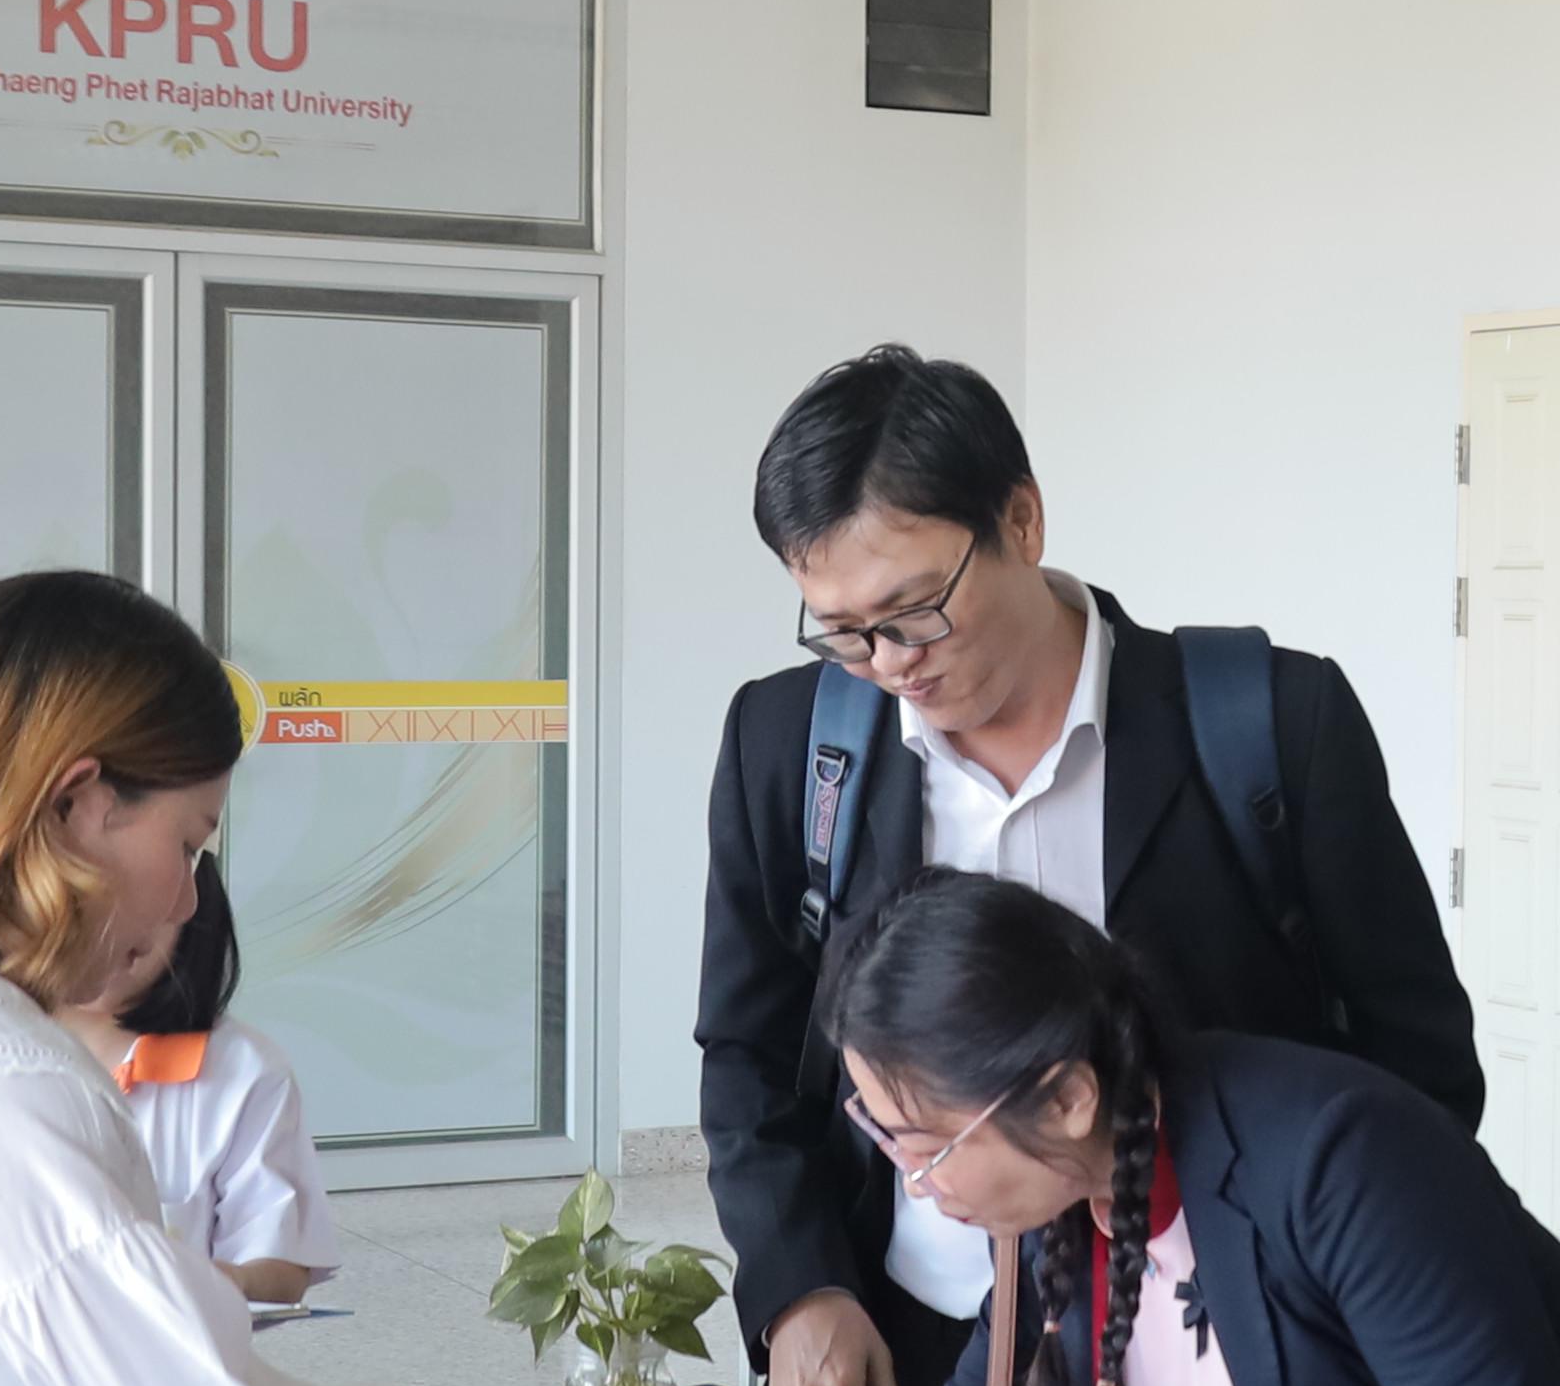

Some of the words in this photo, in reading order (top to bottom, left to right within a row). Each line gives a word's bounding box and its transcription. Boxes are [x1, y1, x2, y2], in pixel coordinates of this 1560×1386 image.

[86, 73, 149, 102] Phet
[156, 79, 275, 112] Rajabhat
[282, 89, 412, 127] University
[279, 687, 322, 707] ผลัก
[278, 719, 329, 738] Push
